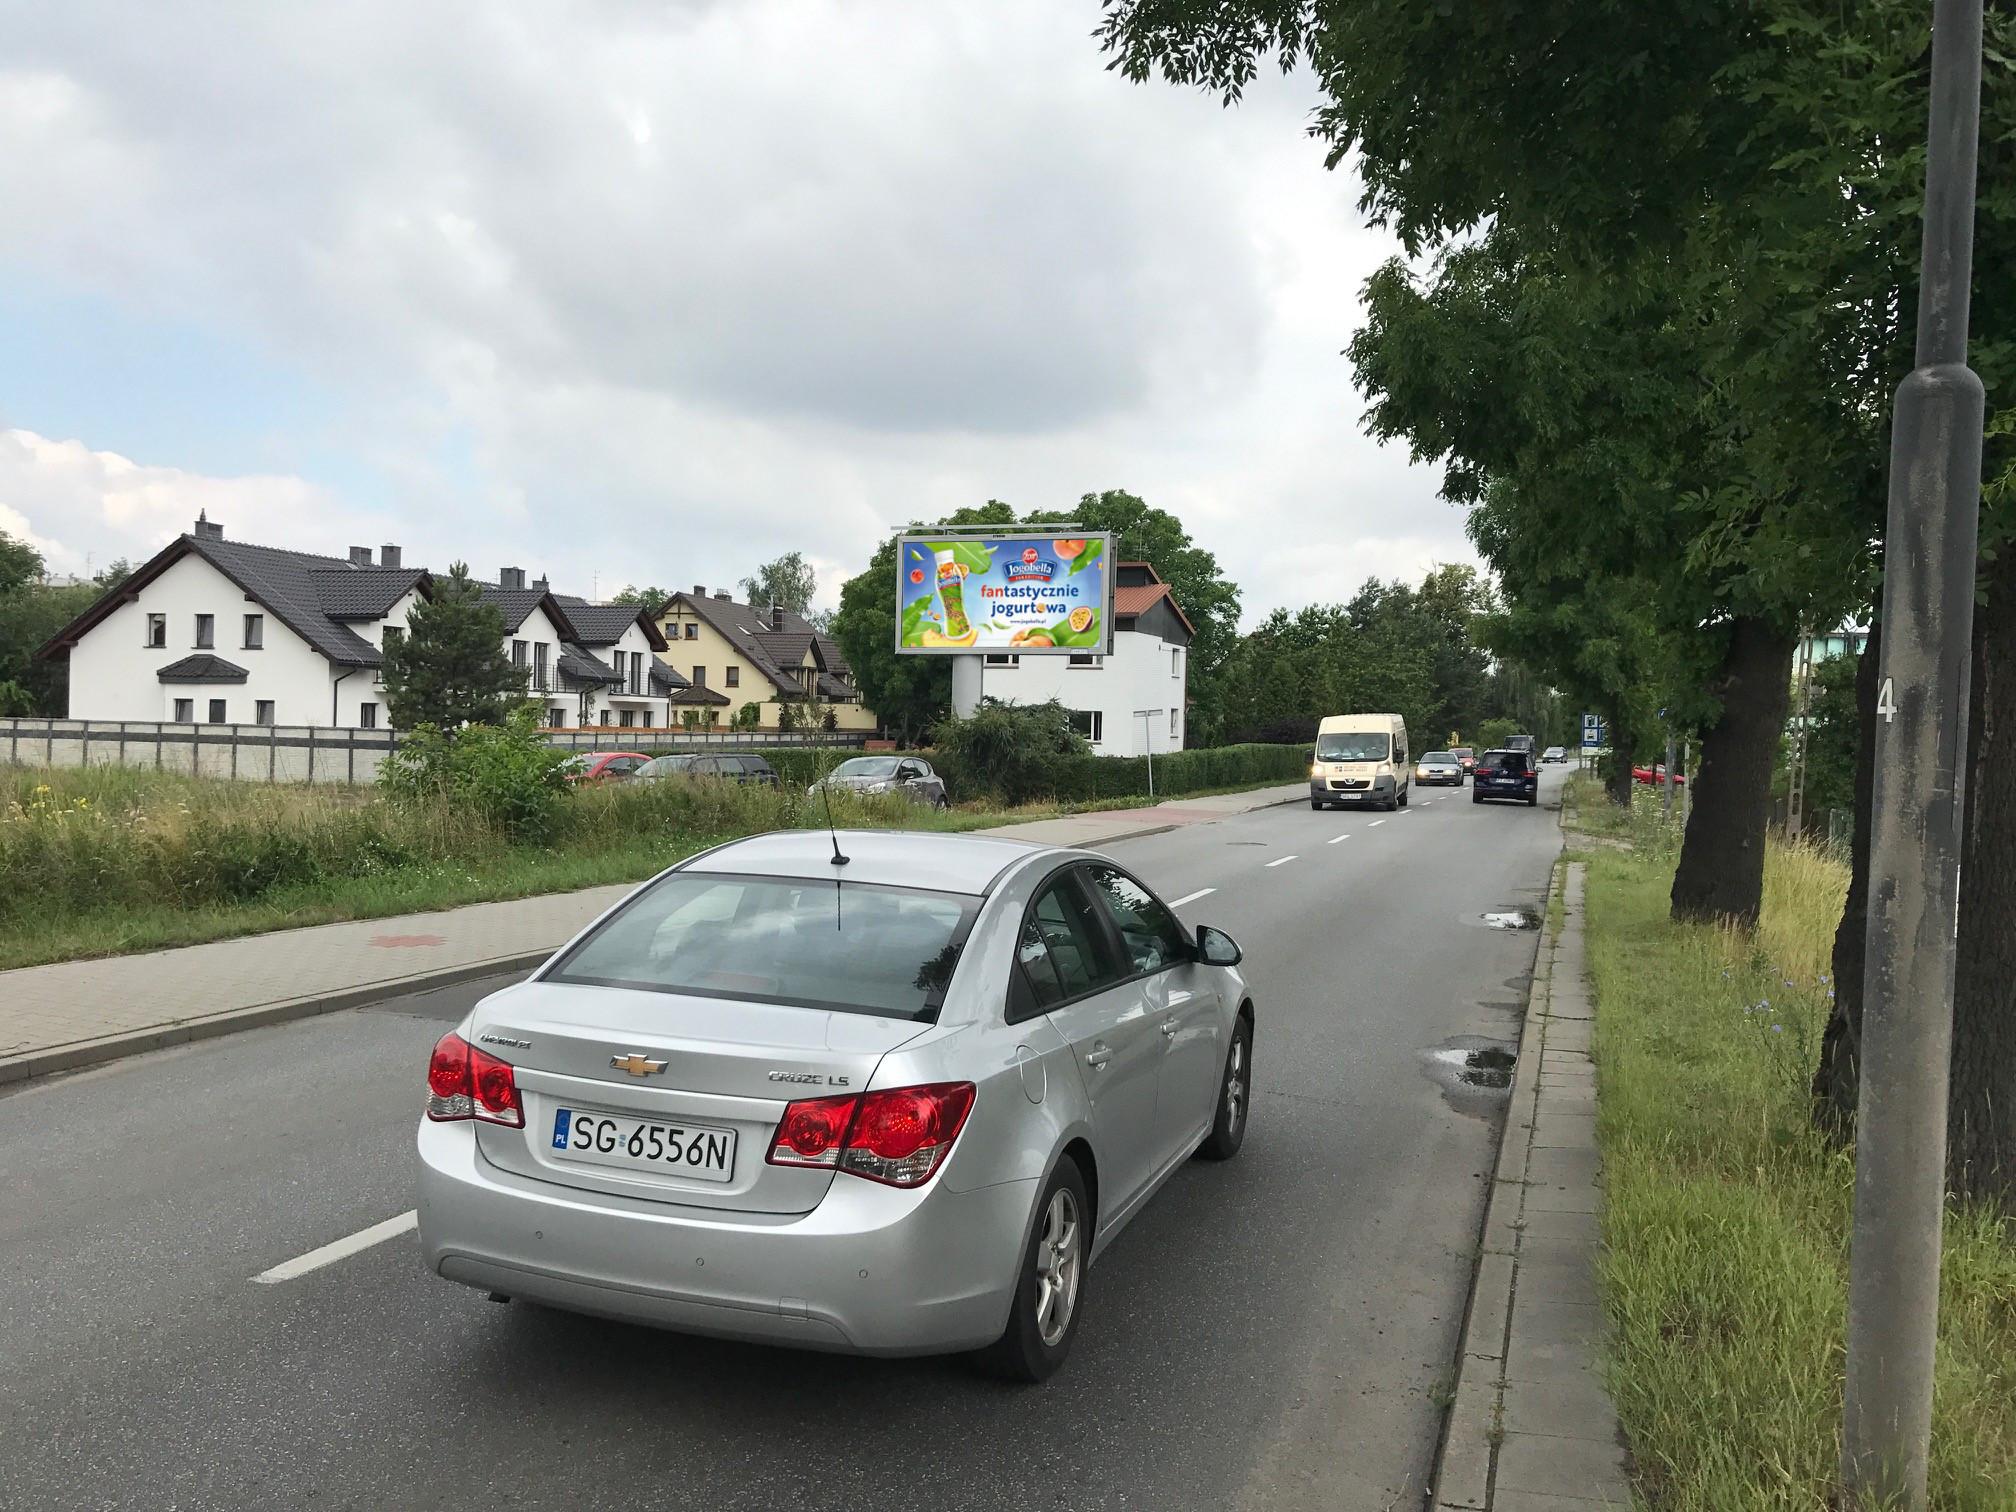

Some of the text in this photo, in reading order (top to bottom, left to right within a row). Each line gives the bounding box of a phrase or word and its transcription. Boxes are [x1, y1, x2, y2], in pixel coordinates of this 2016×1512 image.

[1009, 563, 1052, 576] Jogobella
[981, 584, 1079, 600] fantastycznie
[1877, 677, 1897, 723] 4
[480, 1033, 532, 1049] CHEVROLET
[768, 1070, 850, 1086] CRUZE LS
[555, 1134, 566, 1145] PL
[573, 1116, 728, 1170] SG 6556N
